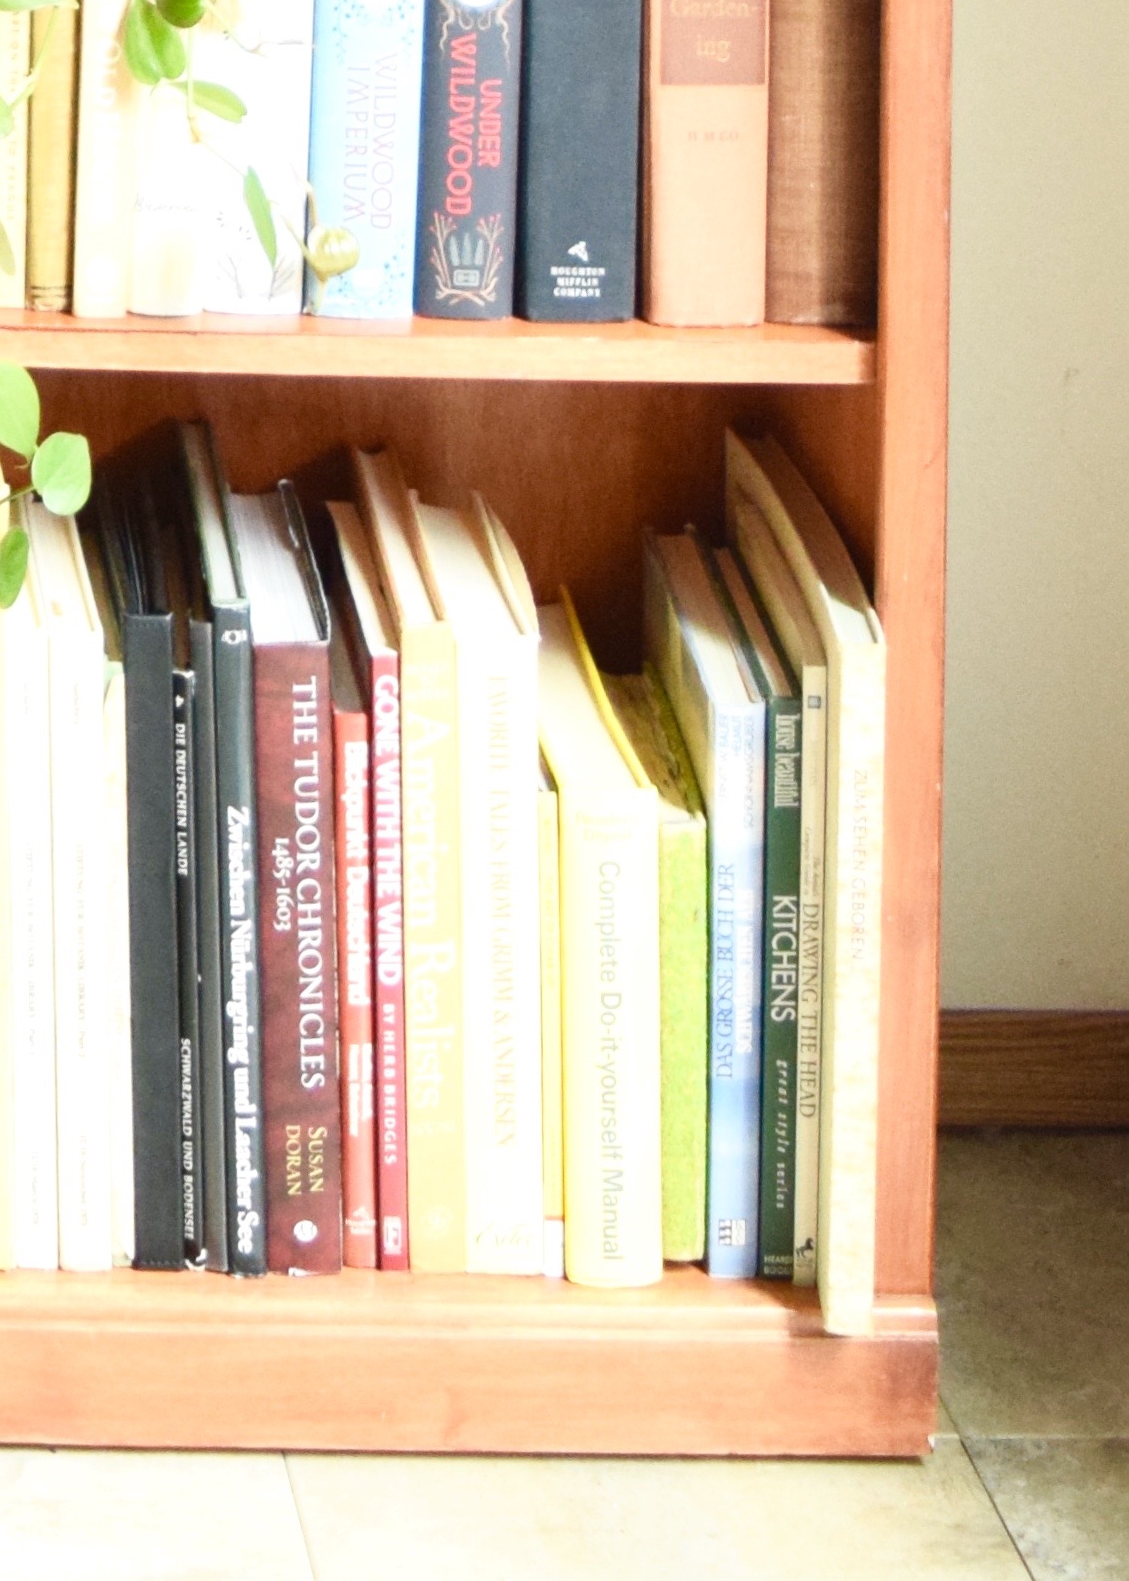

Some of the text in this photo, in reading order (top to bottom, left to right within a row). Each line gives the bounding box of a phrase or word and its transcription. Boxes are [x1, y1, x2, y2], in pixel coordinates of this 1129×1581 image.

[445, 33, 477, 216] WILDWOOD
[477, 79, 503, 168] UNDER
[696, 33, 732, 62] ing
[342, 65, 371, 223] IMPERIUM
[370, 53, 399, 231] WILDWOOD
[549, 266, 607, 276] HOUGHTON
[552, 287, 602, 298] COMPANY
[556, 276, 599, 287] MIFFLIN
[174, 722, 189, 877] DIE DEUTSCHEN LANDE
[272, 836, 295, 933] 1485-1603
[292, 675, 326, 1089] THE TUDOR CHRONICLES
[340, 740, 371, 1006] Blickpunkt Deutschland
[374, 674, 403, 986] GONE WITH THE WIND
[406, 709, 453, 929] American
[851, 768, 868, 961] ZUM SEHEN GEBOREN
[226, 804, 261, 1254] Zwischen Nürburgring und Laacher See
[408, 937, 457, 1110] Realists
[490, 860, 516, 1147] FROM GRIMM ANDERSEN
[716, 864, 735, 1079] DAS GROSSE BUCH DER
[770, 894, 798, 1023] KITCHENS
[799, 902, 820, 1119] DRAWING THE HEAD
[180, 1037, 196, 1240] SCHWARZWALD UND BODENSEE
[382, 1002, 398, 1165] BY HERB BRIDGES
[594, 860, 624, 1262] Complete Do-it-yourself Manual
[775, 1058, 790, 1210] great style series
[285, 1124, 302, 1197] DORAN
[307, 1125, 329, 1194] SUSAN
